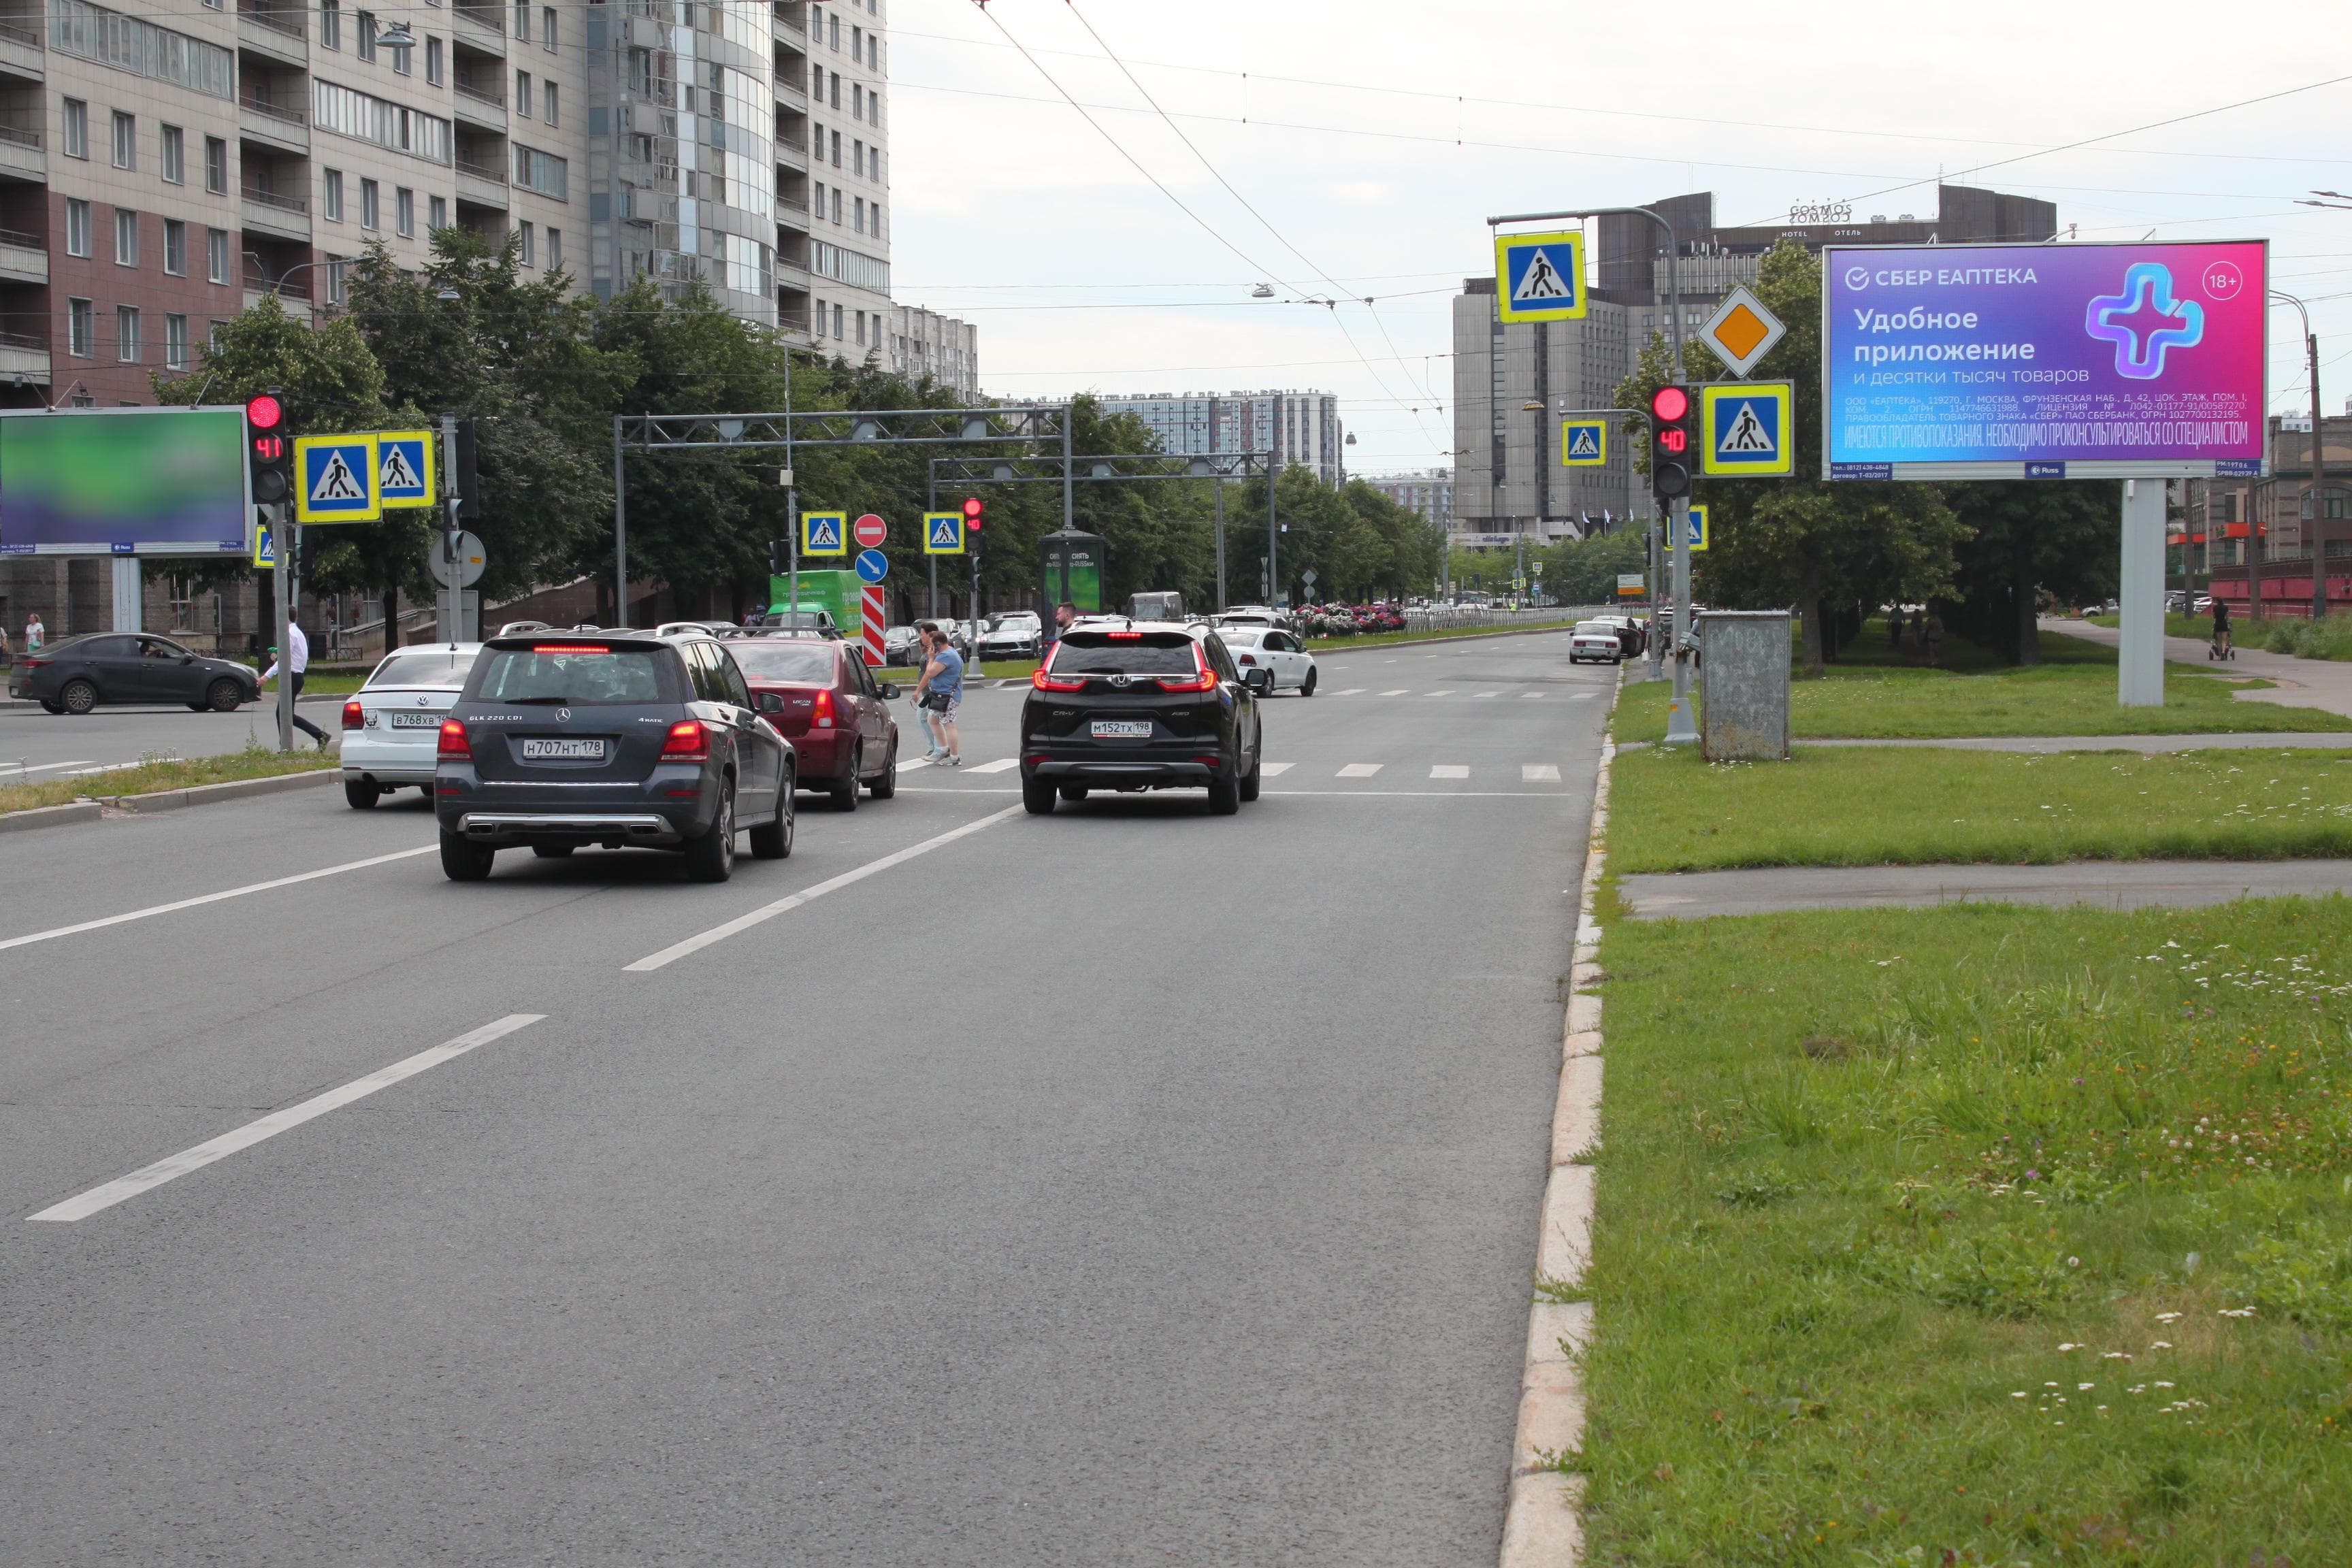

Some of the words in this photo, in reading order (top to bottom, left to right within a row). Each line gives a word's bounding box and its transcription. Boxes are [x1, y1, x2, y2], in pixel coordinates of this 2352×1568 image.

[1875, 270, 1932, 286] СБЕР
[1938, 268, 2038, 284] ЕАПТЕКА
[2209, 275, 2237, 288] 18+
[1854, 306, 1978, 333] Удобное
[1855, 343, 2035, 366] приложение
[1854, 373, 1865, 385] и
[1870, 372, 1946, 386] десятки
[1952, 370, 2006, 383] тысяч
[2012, 369, 2089, 385] товаров
[1845, 397, 1867, 405] ООО
[1928, 396, 1962, 405] 119270,
[1977, 395, 2019, 404] МОСКВА,
[2023, 395, 2091, 403] ФРУНЗЕНСКАЯ
[2095, 394, 2120, 403] НАБ.,
[2123, 394, 2133, 403] Д.
[2137, 394, 2151, 402] 42,
[2155, 393, 2177, 403] ЦОК.
[2181, 393, 2209, 402] ЭТАЖ,
[2213, 393, 2238, 402] ПОМ.
[1908, 405, 1933, 413] ОГРН
[2036, 403, 2088, 412] ЛИЦЕНЗИЯ
[1846, 413, 1936, 422] ПРАВООБЛАДАТЕЛЬ
[1940, 412, 1993, 421] ТОВАРНОГО
[1996, 412, 2027, 421] ЗНАКА
[2029, 412, 2062, 420] «СБЕР»
[2065, 411, 2085, 419] ПАО
[2087, 410, 2138, 419] СБЕРБАНК,
[2141, 410, 2166, 419] ОГРН
[1661, 430, 1685, 452] 40
[1845, 425, 1886, 448] ИМЕЮТСЯ
[1889, 423, 1984, 448] ПРОТИВОПОКАЗАНИЯ.
[1987, 423, 2047, 451] НЕОБХОДИМО
[2049, 421, 2160, 447] ПРОКОНСУЛЬТИРОВАТЬСЯ
[2162, 421, 2174, 446] СО
[2175, 421, 2248, 450] СПЕЦИАЛИСТОМ
[256, 438, 281, 457] 41
[967, 518, 981, 530] 40
[1094, 722, 1132, 733] М152ТХ
[1134, 722, 1149, 730] 198
[527, 740, 578, 754] Н707НТ
[581, 740, 600, 751] 178
